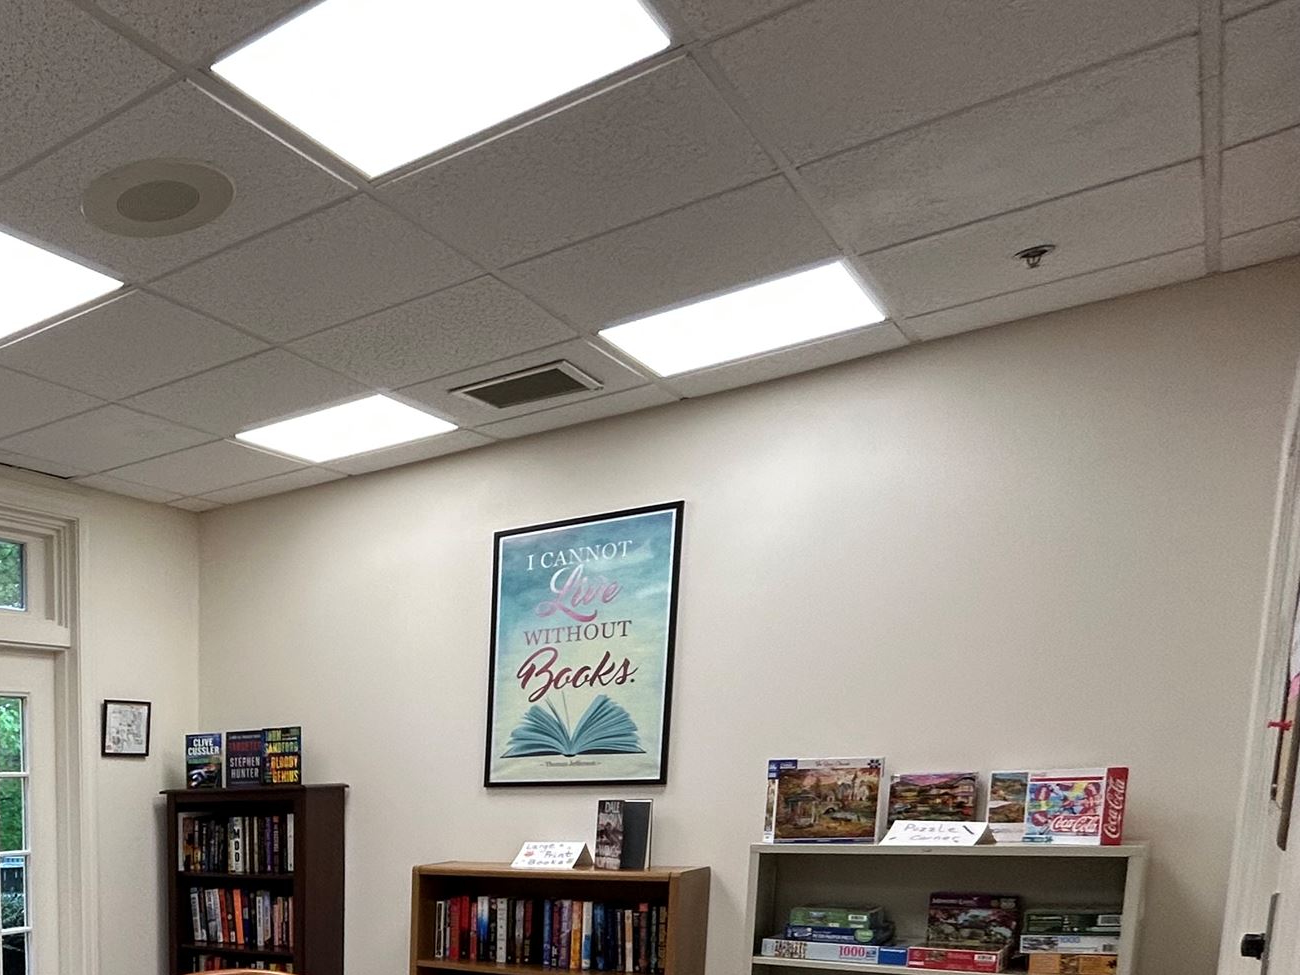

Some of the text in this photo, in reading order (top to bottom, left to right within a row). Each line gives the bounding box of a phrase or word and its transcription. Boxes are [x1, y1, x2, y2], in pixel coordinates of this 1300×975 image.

[527, 540, 633, 571] I CANNOT
[535, 563, 624, 623] Live
[523, 620, 633, 647] WITHOUT
[516, 646, 639, 703] Books.
[193, 738, 213, 748] CLIVE
[264, 741, 298, 753] SANDFORD
[188, 746, 220, 756] CUSSLER
[230, 756, 260, 767] STEPHEN
[271, 755, 298, 769] BLOODY
[231, 768, 259, 779] HUNTER
[272, 770, 299, 783] GENIUS
[605, 801, 620, 813] DALE
[904, 823, 959, 833] Puzzle
[1051, 816, 1100, 832] Coca-Cola
[840, 945, 865, 957] 1000
